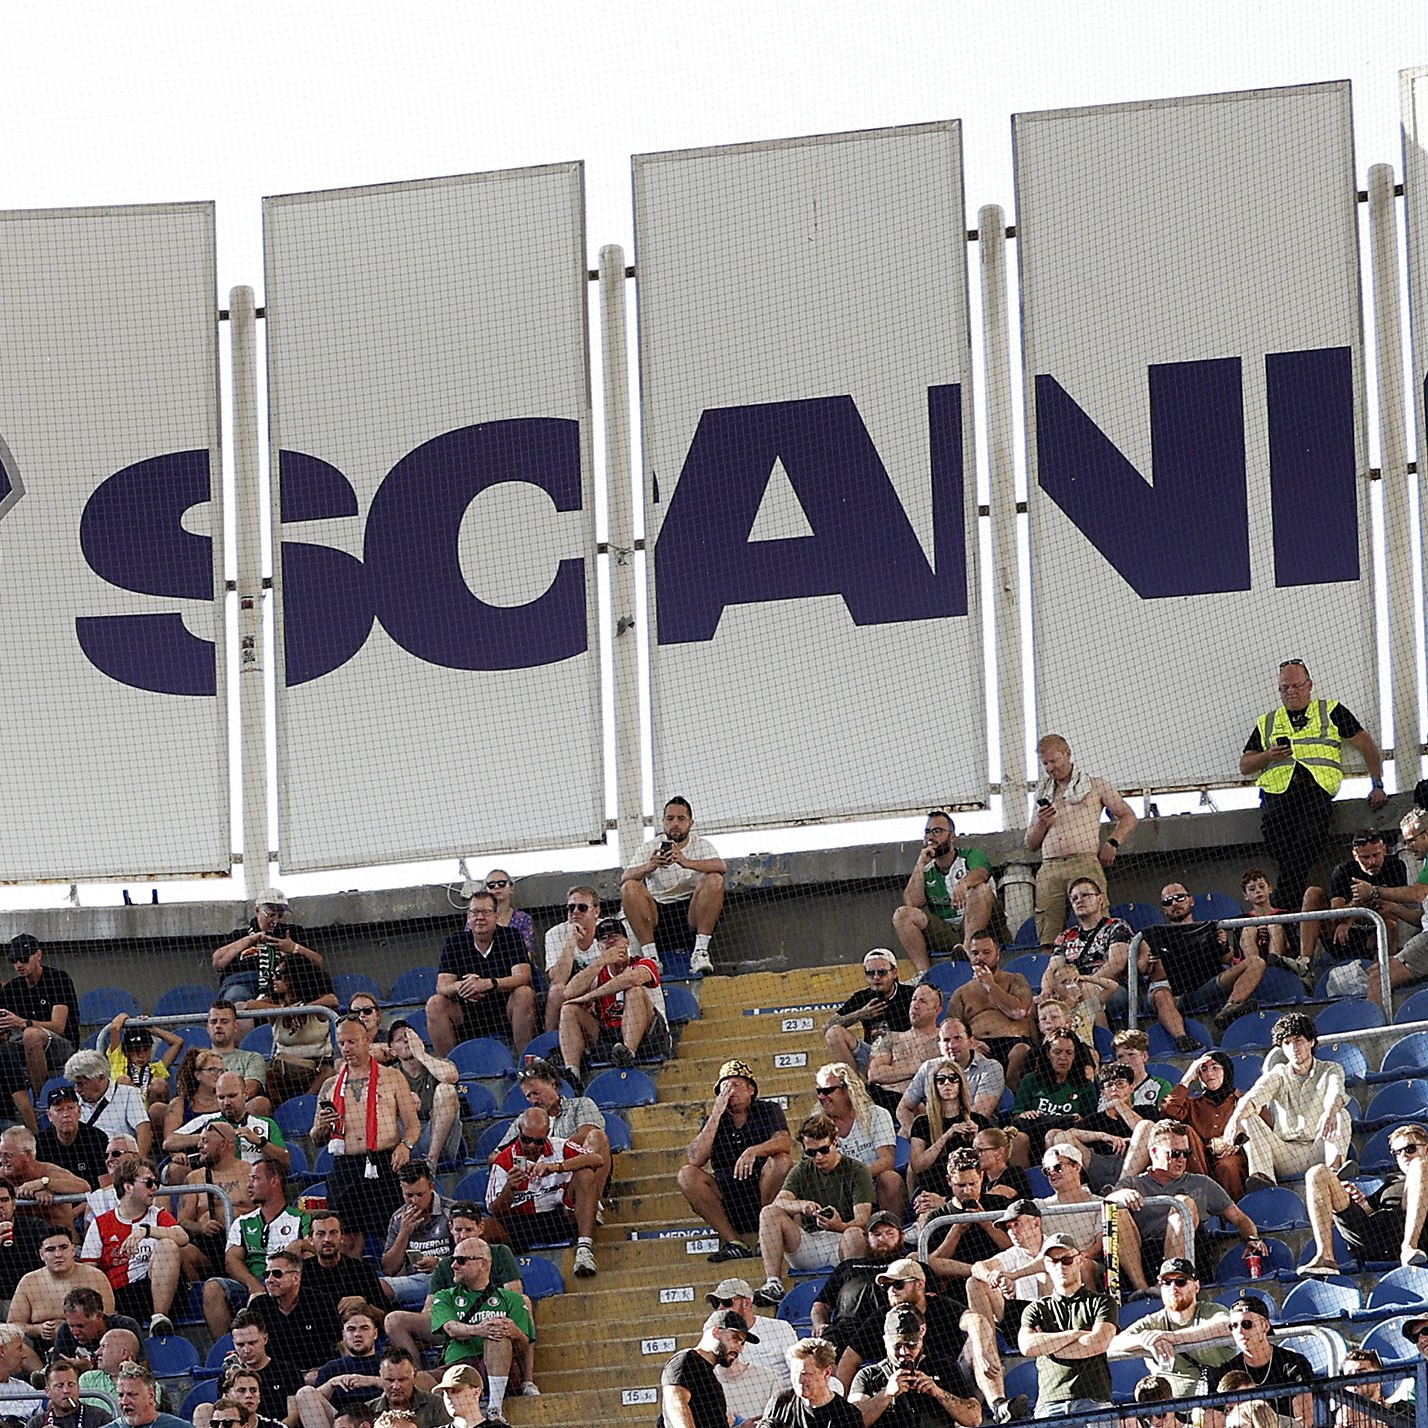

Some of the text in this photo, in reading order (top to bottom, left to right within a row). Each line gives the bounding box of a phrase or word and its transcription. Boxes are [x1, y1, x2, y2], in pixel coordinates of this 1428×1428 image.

[75, 347, 1428, 697] SCANI
[786, 1021, 798, 1030] 23
[779, 1056, 791, 1066] 22
[691, 1241, 703, 1250] 18
[665, 1290, 677, 1300] 17
[647, 1341, 659, 1351] 16
[627, 1390, 639, 1400] 15
